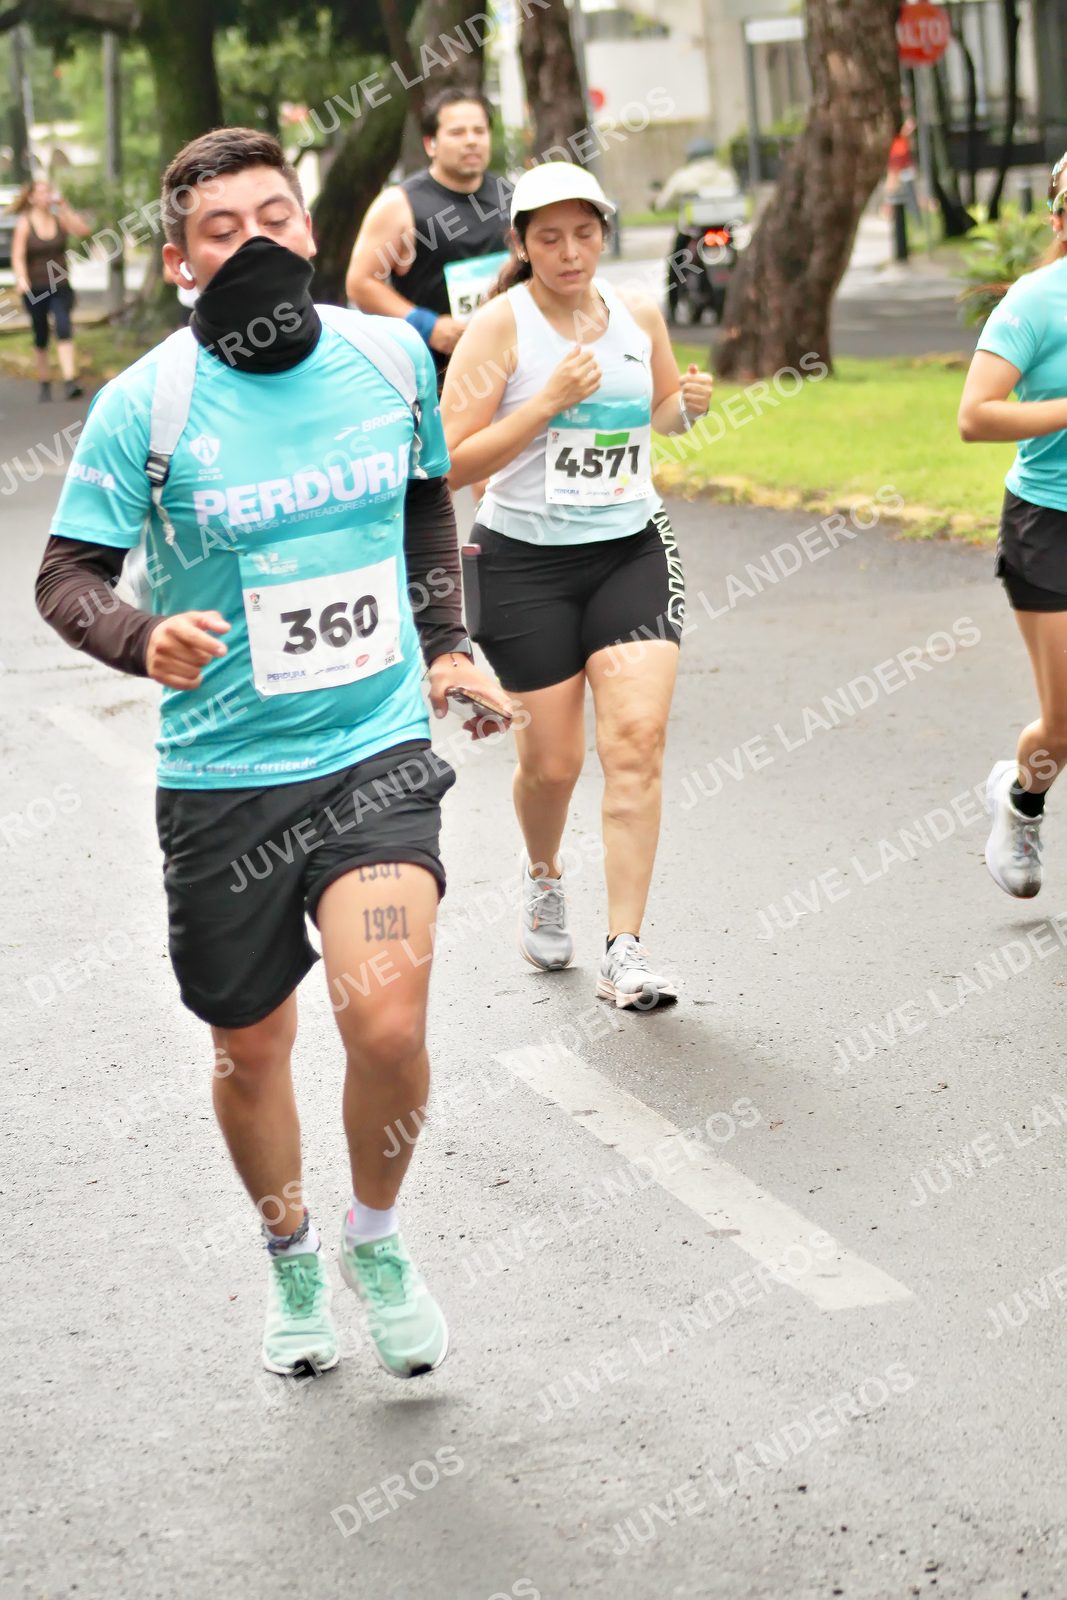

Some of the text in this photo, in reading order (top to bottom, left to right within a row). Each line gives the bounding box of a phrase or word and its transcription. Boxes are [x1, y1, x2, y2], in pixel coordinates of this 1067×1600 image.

[555, 445, 640, 479] 4571
[280, 594, 379, 655] 360
[254, 757, 318, 772] corriendo
[363, 903, 410, 942] 1921
